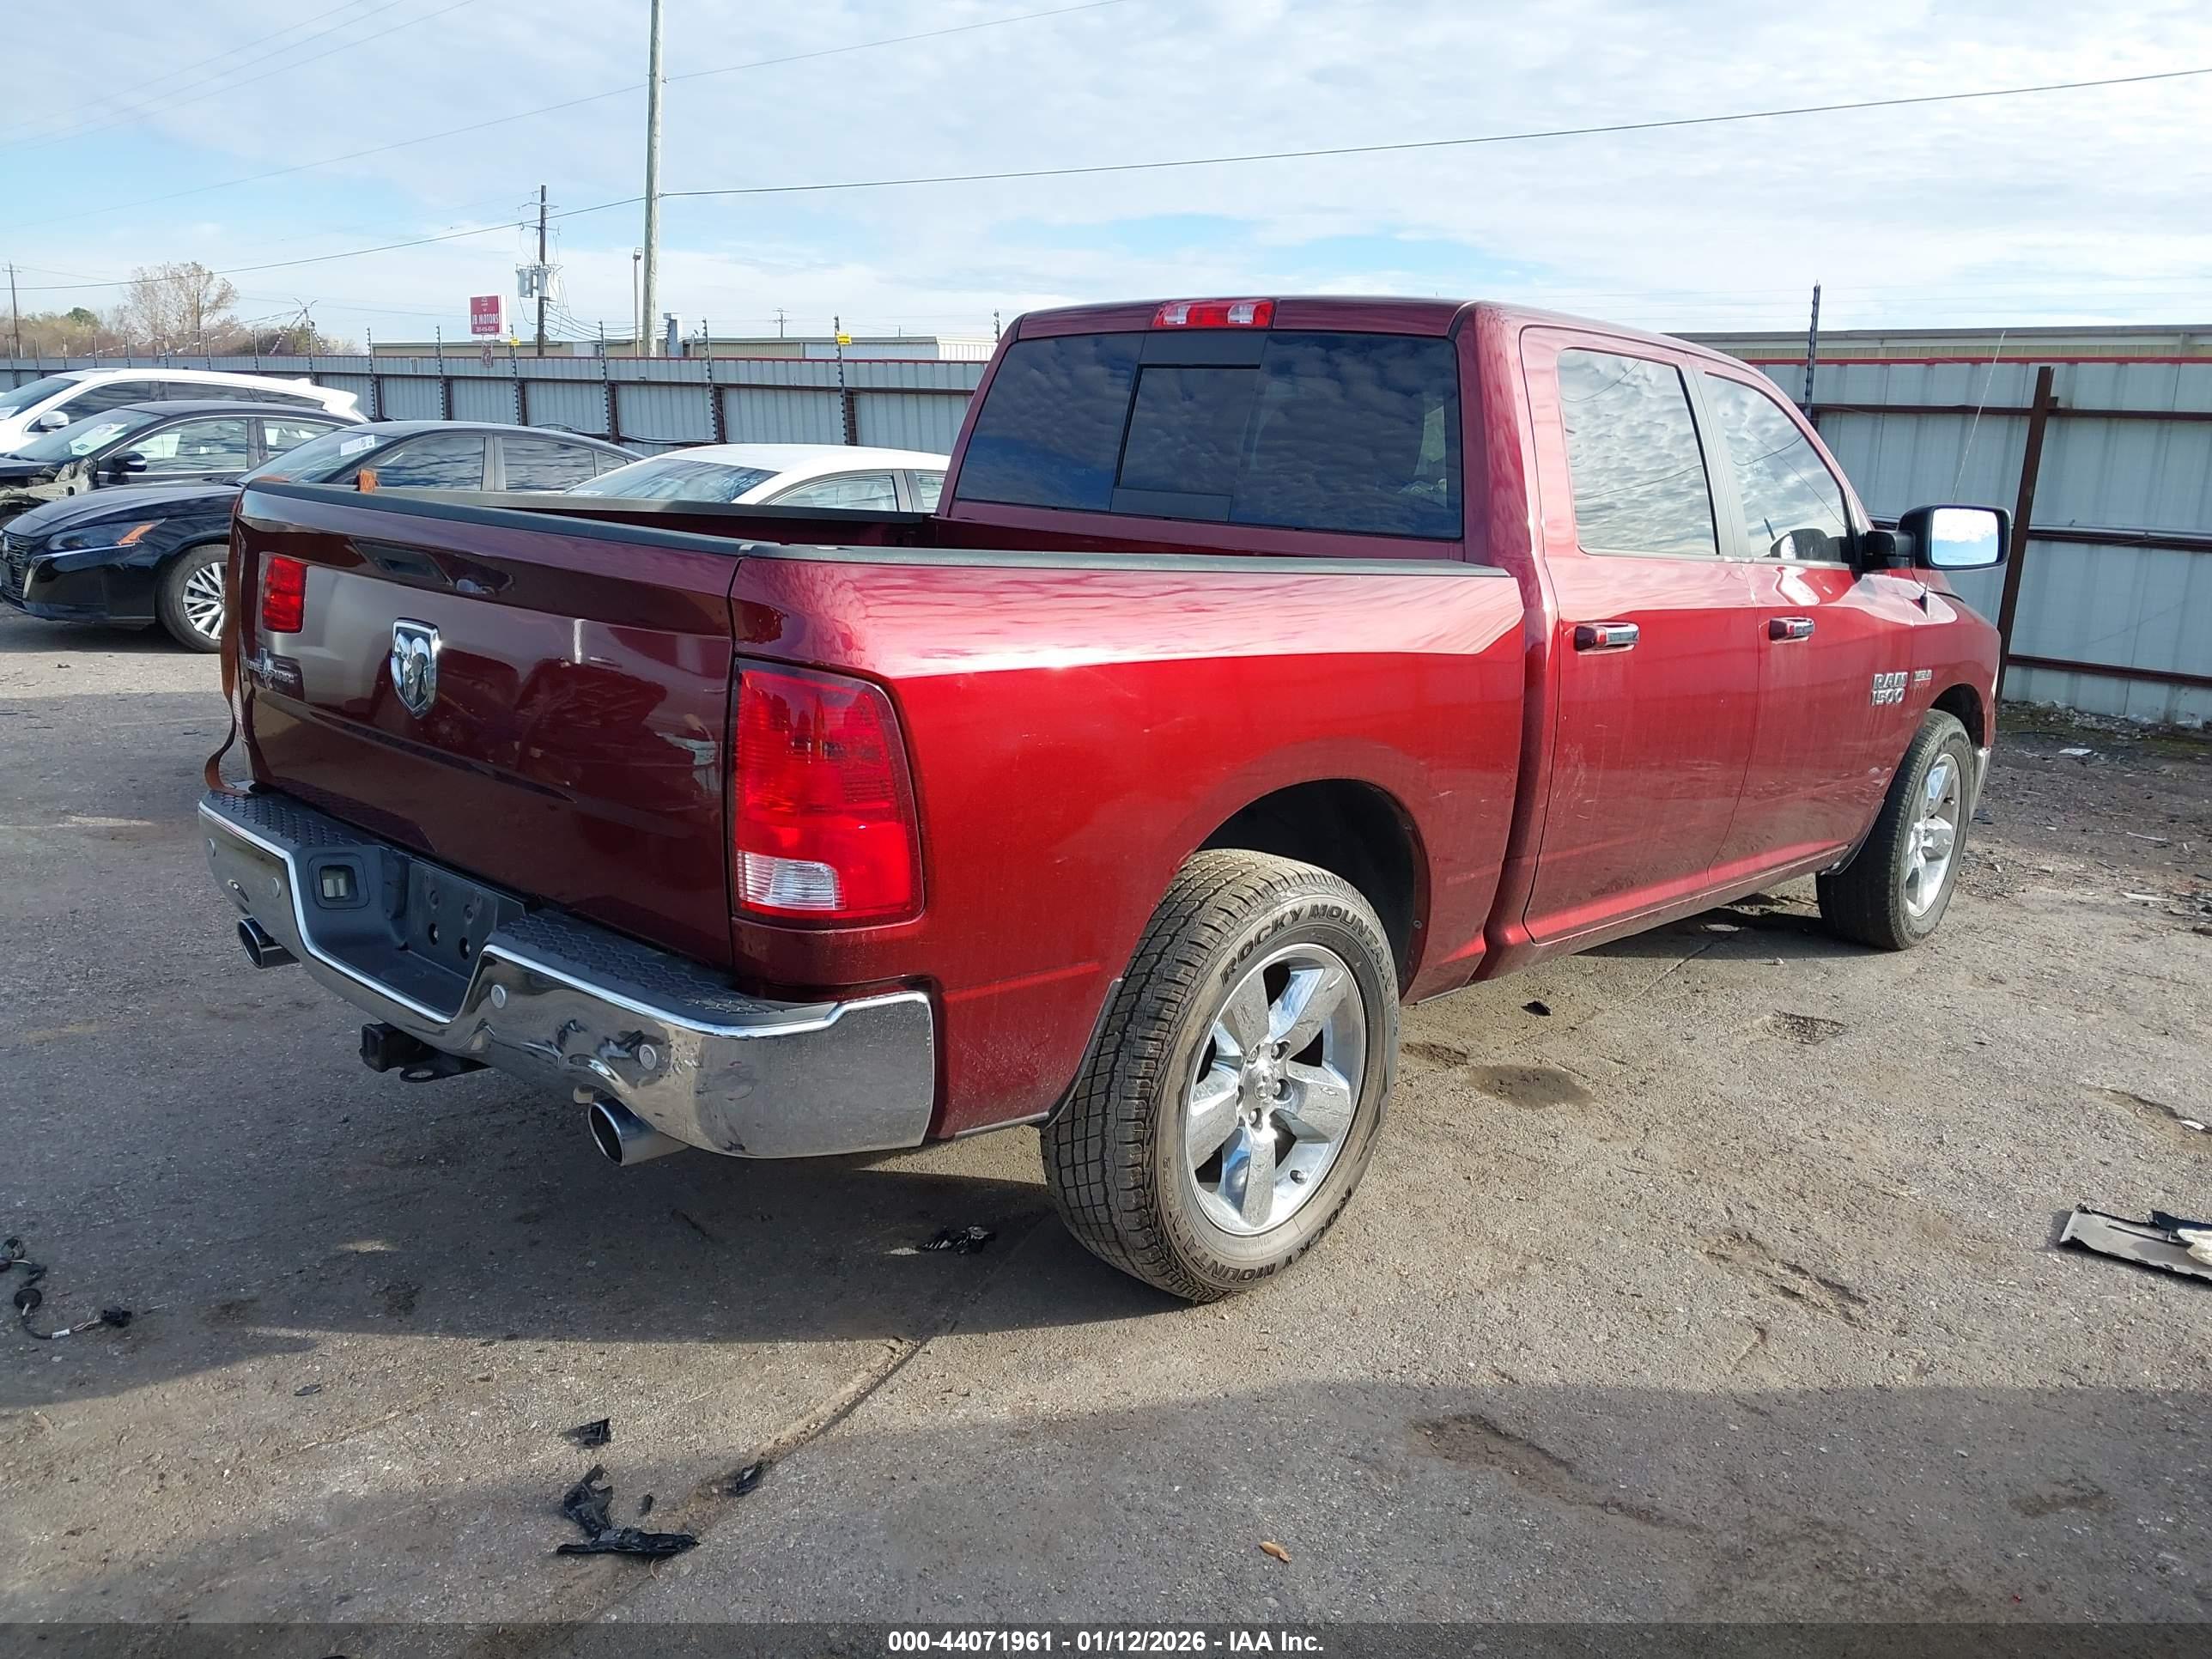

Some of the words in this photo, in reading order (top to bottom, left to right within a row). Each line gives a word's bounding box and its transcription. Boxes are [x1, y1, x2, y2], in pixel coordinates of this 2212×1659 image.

[478, 313, 499, 325] MOTORS
[1871, 688, 1905, 706] 1500
[1873, 672, 1908, 688] RAM
[1220, 907, 1304, 987] ROCKY
[1308, 904, 1395, 993] MOUNTAIN
[1169, 1208, 1277, 1283] MOUNTAIN
[1284, 1185, 1352, 1269] ROCKY
